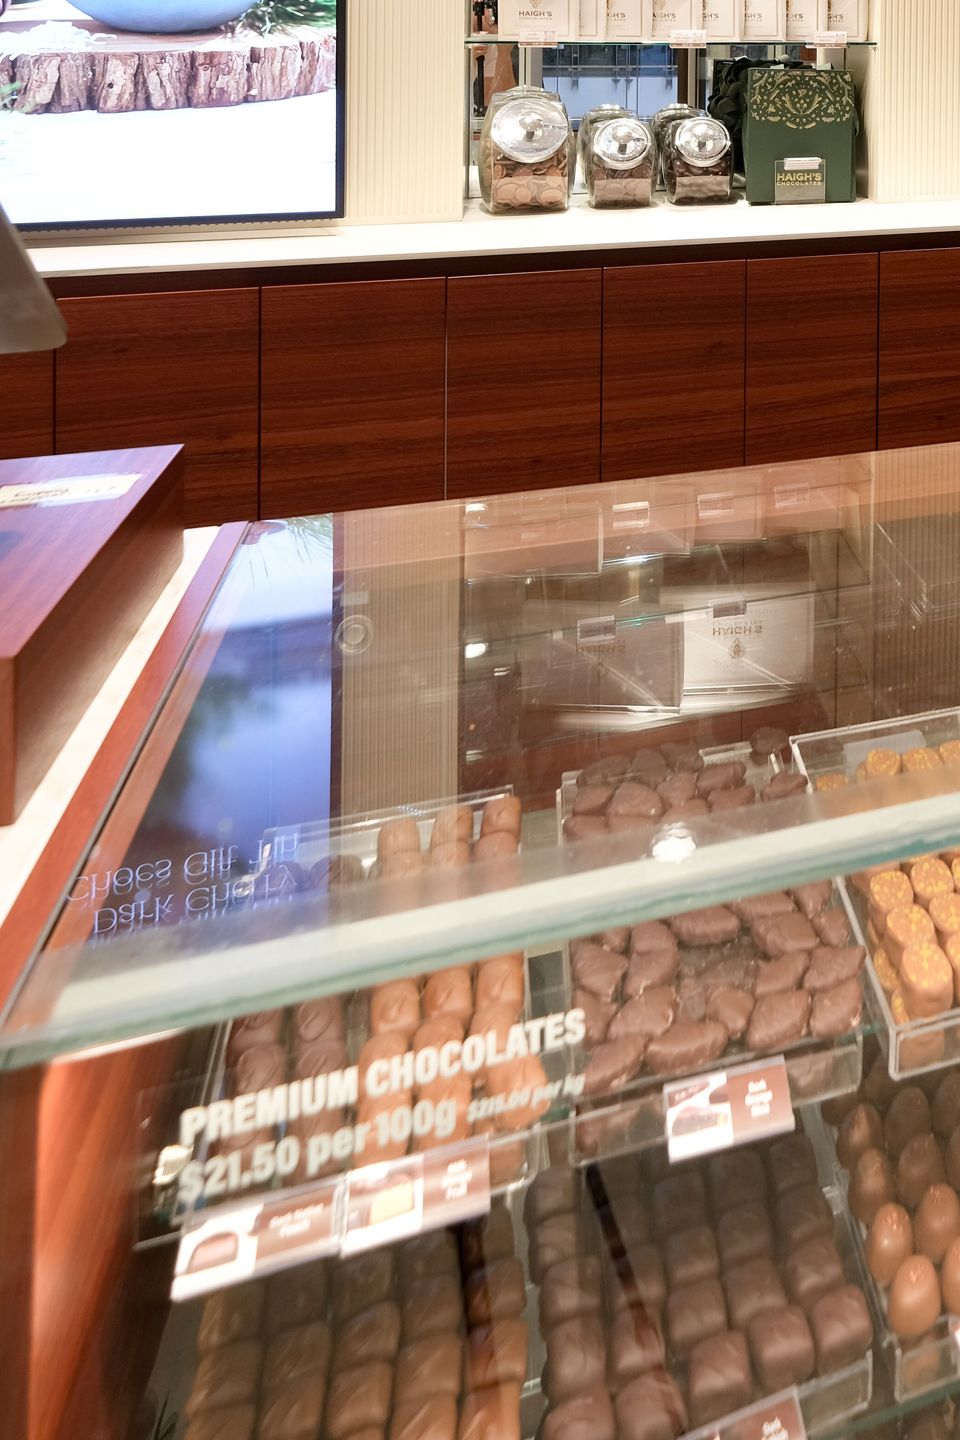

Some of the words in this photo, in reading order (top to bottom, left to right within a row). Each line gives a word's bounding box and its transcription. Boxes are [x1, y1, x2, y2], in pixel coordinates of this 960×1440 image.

[776, 172, 822, 182] HAIGH'S
[178, 1065, 360, 1147] PREMIUM
[364, 1007, 587, 1097] CHOCOLATES
[177, 1132, 302, 1204] $21.50
[305, 1121, 373, 1179] per
[373, 1099, 457, 1145] 100g
